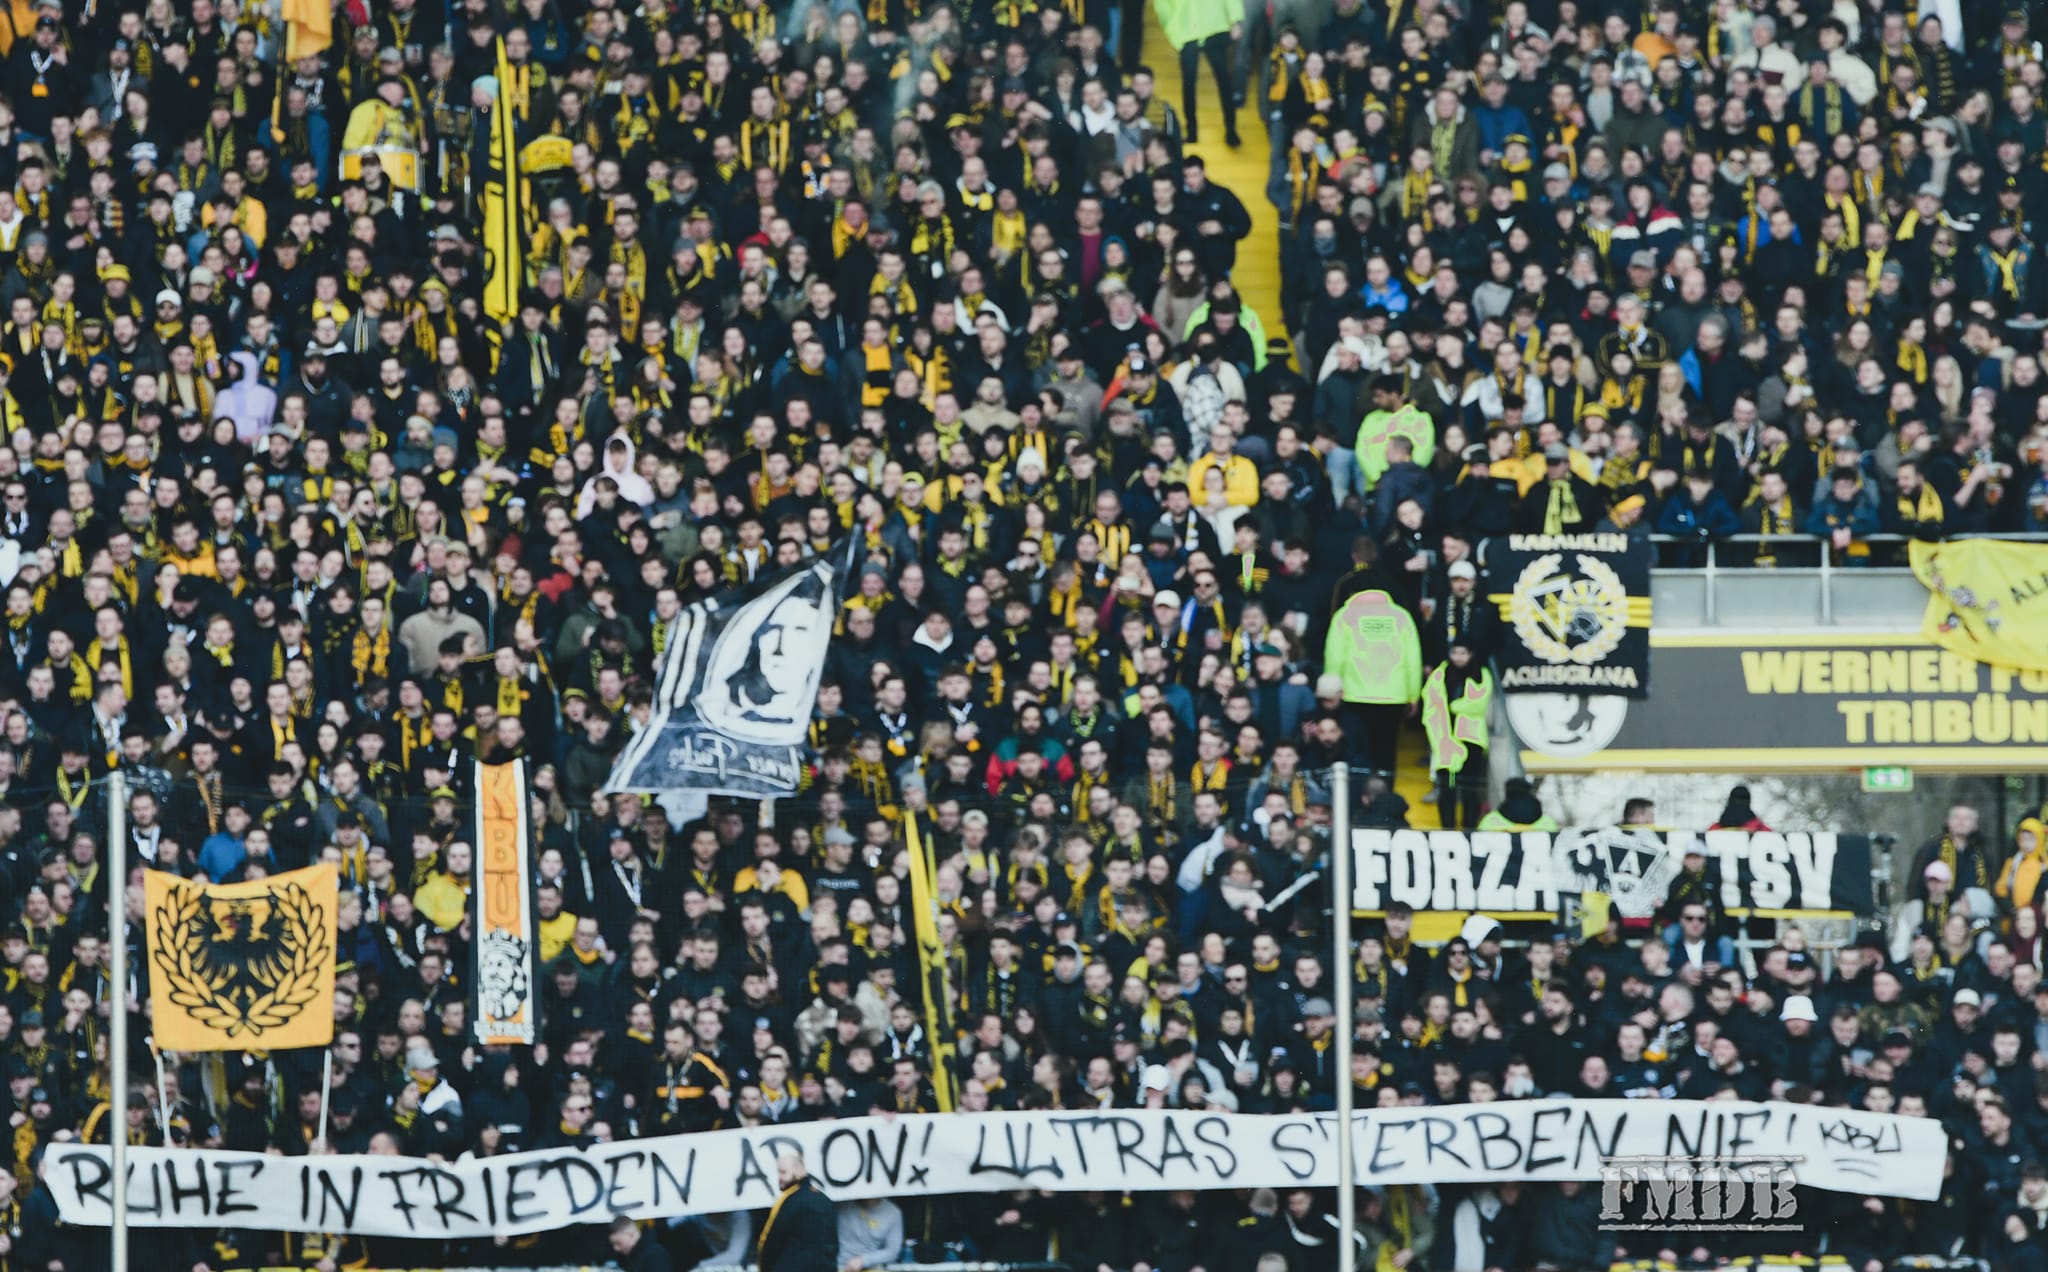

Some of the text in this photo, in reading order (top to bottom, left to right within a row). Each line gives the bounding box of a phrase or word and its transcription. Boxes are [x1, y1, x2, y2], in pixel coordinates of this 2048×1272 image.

[1742, 650, 1978, 693] WERNER
[1838, 692, 2048, 744] TRIBÜN
[482, 762, 521, 928] KBU
[1352, 829, 1560, 911] FORZA
[58, 1151, 265, 1219] RUHE
[301, 1163, 363, 1229] IN
[378, 1147, 697, 1230] FRIEDEN
[970, 1114, 1238, 1180] ULTRAS
[1271, 1106, 1628, 1179] STERBEN
[1665, 1109, 1797, 1173] NIE!
[1819, 1119, 1902, 1154] KBU
